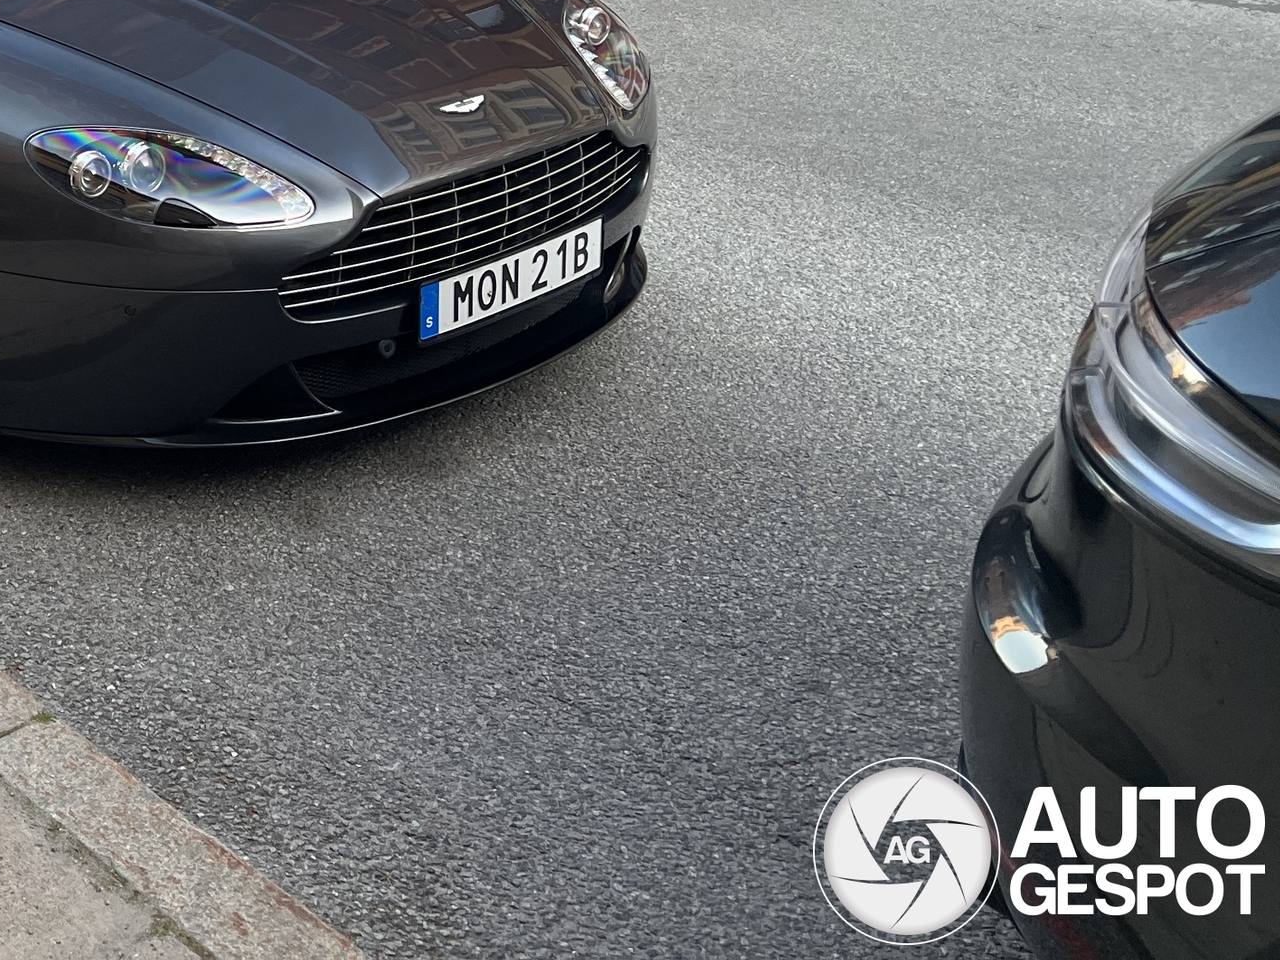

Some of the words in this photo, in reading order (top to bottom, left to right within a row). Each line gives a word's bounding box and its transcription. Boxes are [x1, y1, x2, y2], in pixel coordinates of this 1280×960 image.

[453, 258, 520, 323] MON
[531, 231, 589, 293] 21B
[425, 316, 434, 329] S
